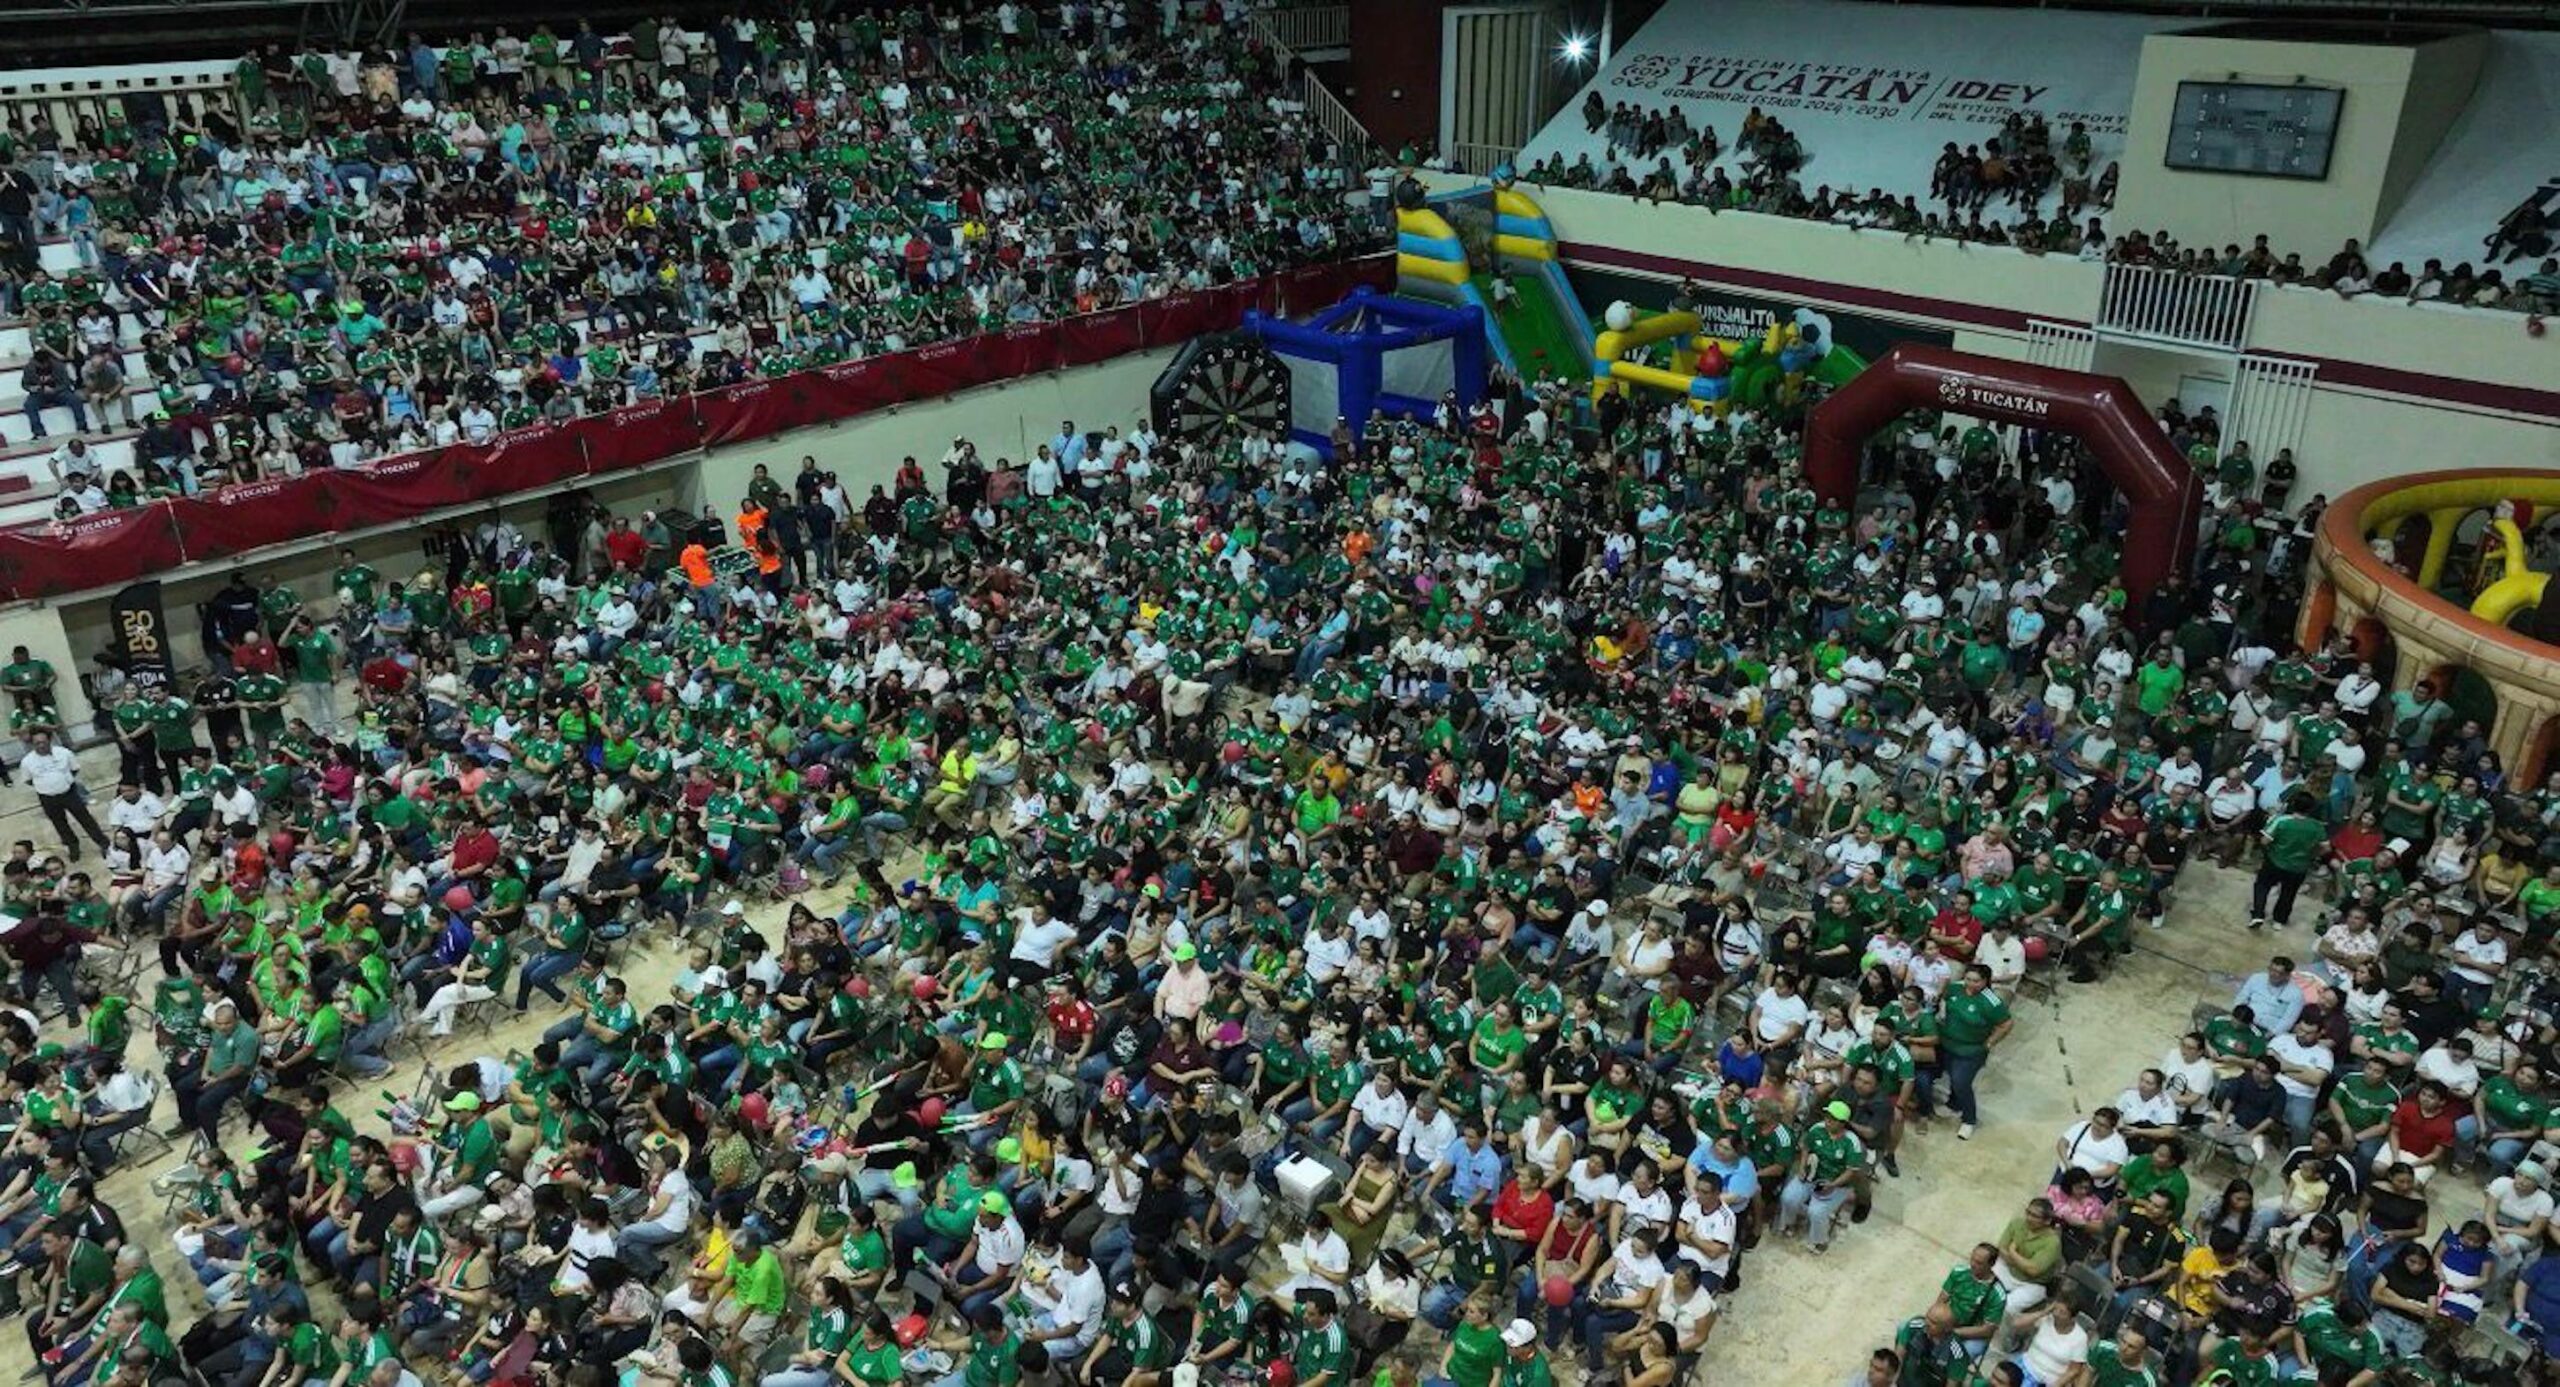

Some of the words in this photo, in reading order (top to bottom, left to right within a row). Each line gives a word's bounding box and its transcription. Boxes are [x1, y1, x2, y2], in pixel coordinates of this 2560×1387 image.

[1689, 56, 1861, 76] RENACIMIENTO
[1867, 68, 1931, 80] MAYA
[1945, 81, 2049, 104] IDEY
[1803, 100, 1844, 115] 2024
[1855, 104, 1900, 119] 2030
[1928, 111, 1956, 122] DEL
[1936, 101, 2014, 114] INSTITUTO
[121, 610, 154, 631] 20
